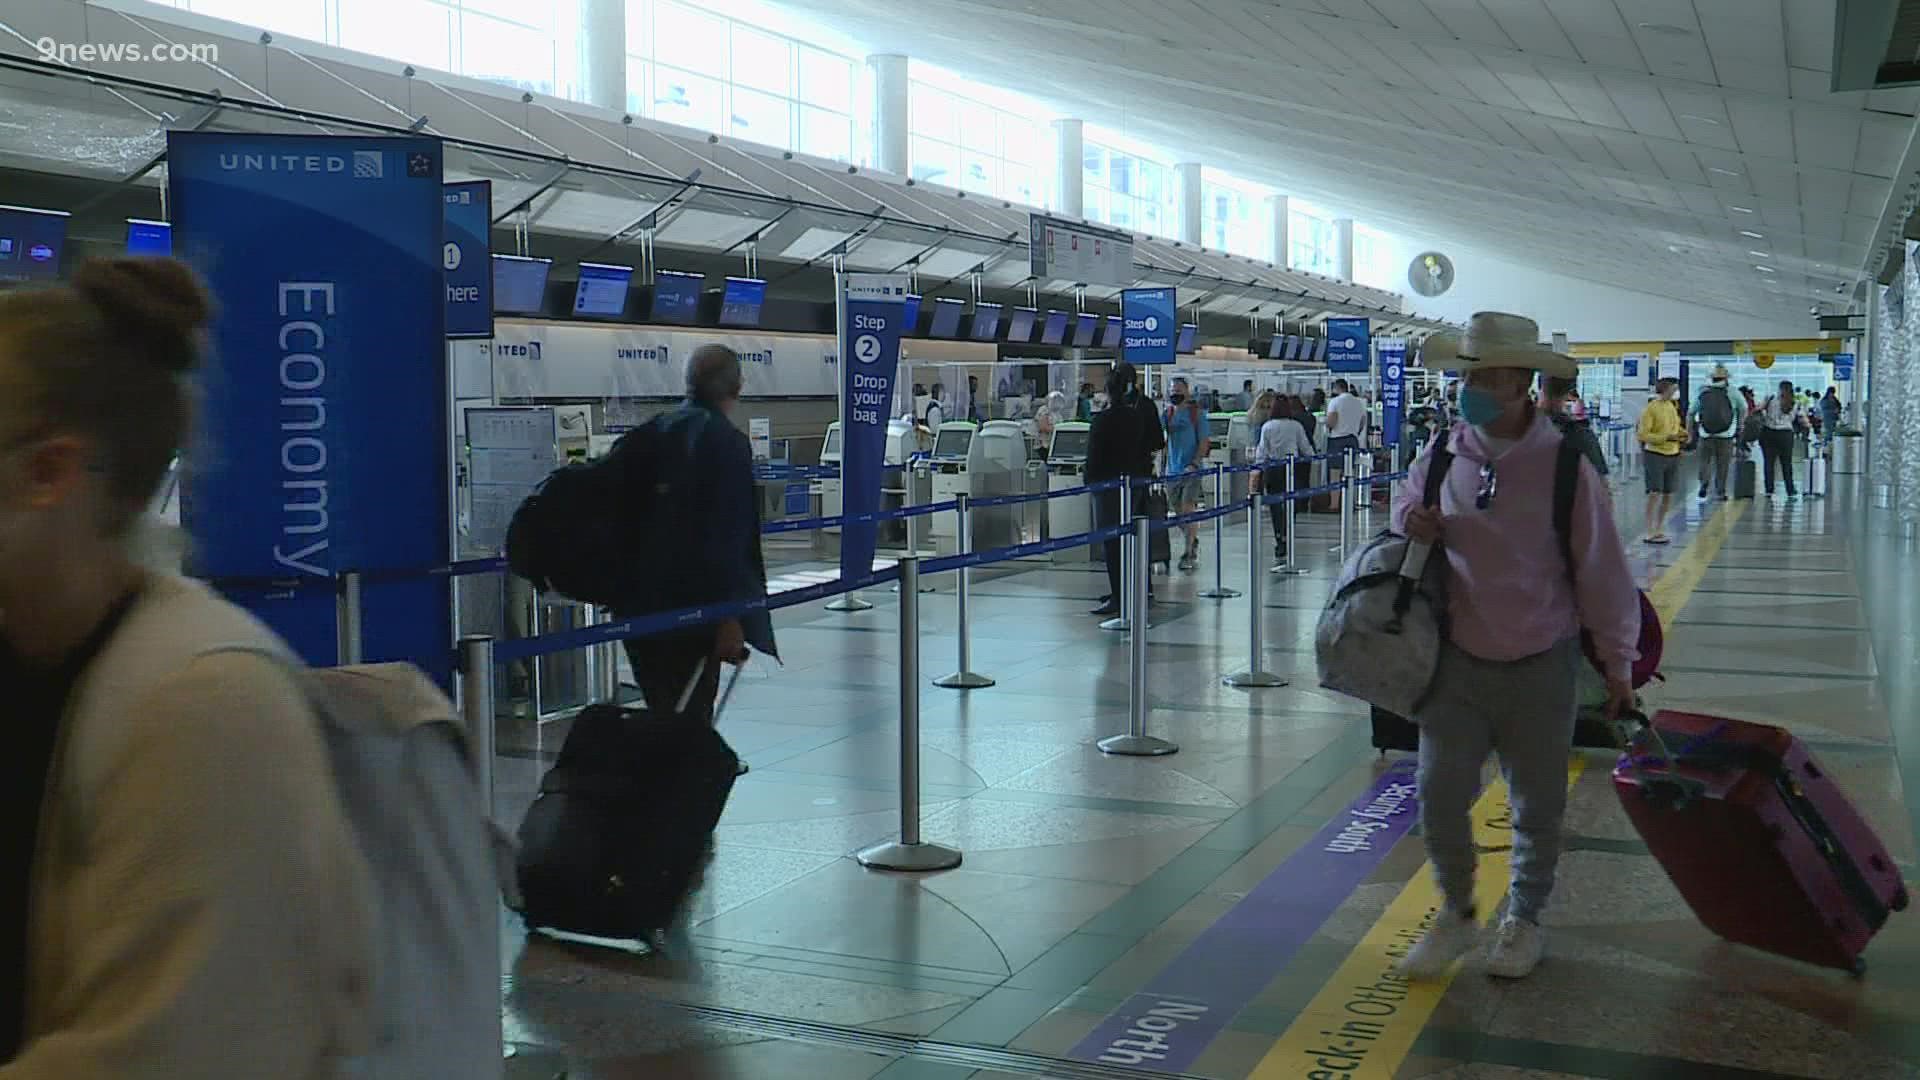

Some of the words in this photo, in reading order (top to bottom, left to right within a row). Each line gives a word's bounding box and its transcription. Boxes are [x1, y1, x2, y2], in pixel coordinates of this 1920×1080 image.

[219, 153, 345, 172] UNITED
[446, 283, 479, 302] here
[855, 315, 886, 330] Step
[1125, 319, 1145, 330] Step
[862, 340, 874, 357] 2
[1125, 337, 1147, 347] Start
[1148, 337, 1168, 347] here
[618, 348, 657, 360] UNITED
[853, 374, 888, 391] Drop
[853, 393, 886, 406] your
[853, 408, 878, 425] bag
[273, 280, 336, 577] Economy
[1323, 820, 1390, 854] South
[1097, 1000, 1209, 1065] North
